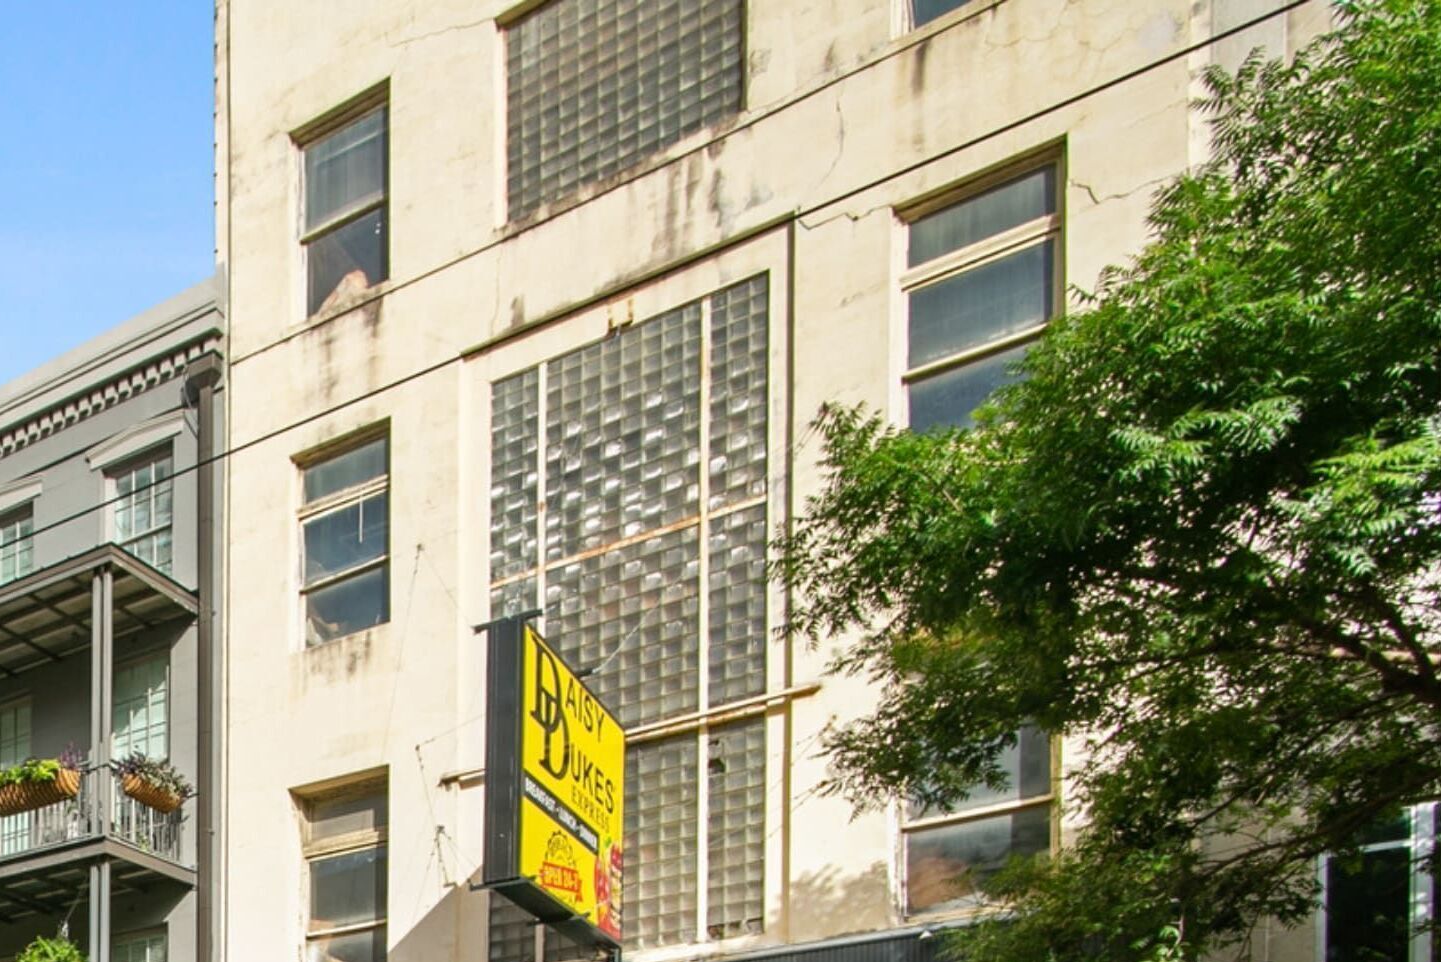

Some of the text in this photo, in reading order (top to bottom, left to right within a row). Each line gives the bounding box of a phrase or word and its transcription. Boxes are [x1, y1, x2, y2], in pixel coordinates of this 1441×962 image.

[530, 634, 606, 744] DAISY
[538, 690, 615, 815] DUKES
[571, 785, 610, 834] EXPRESS
